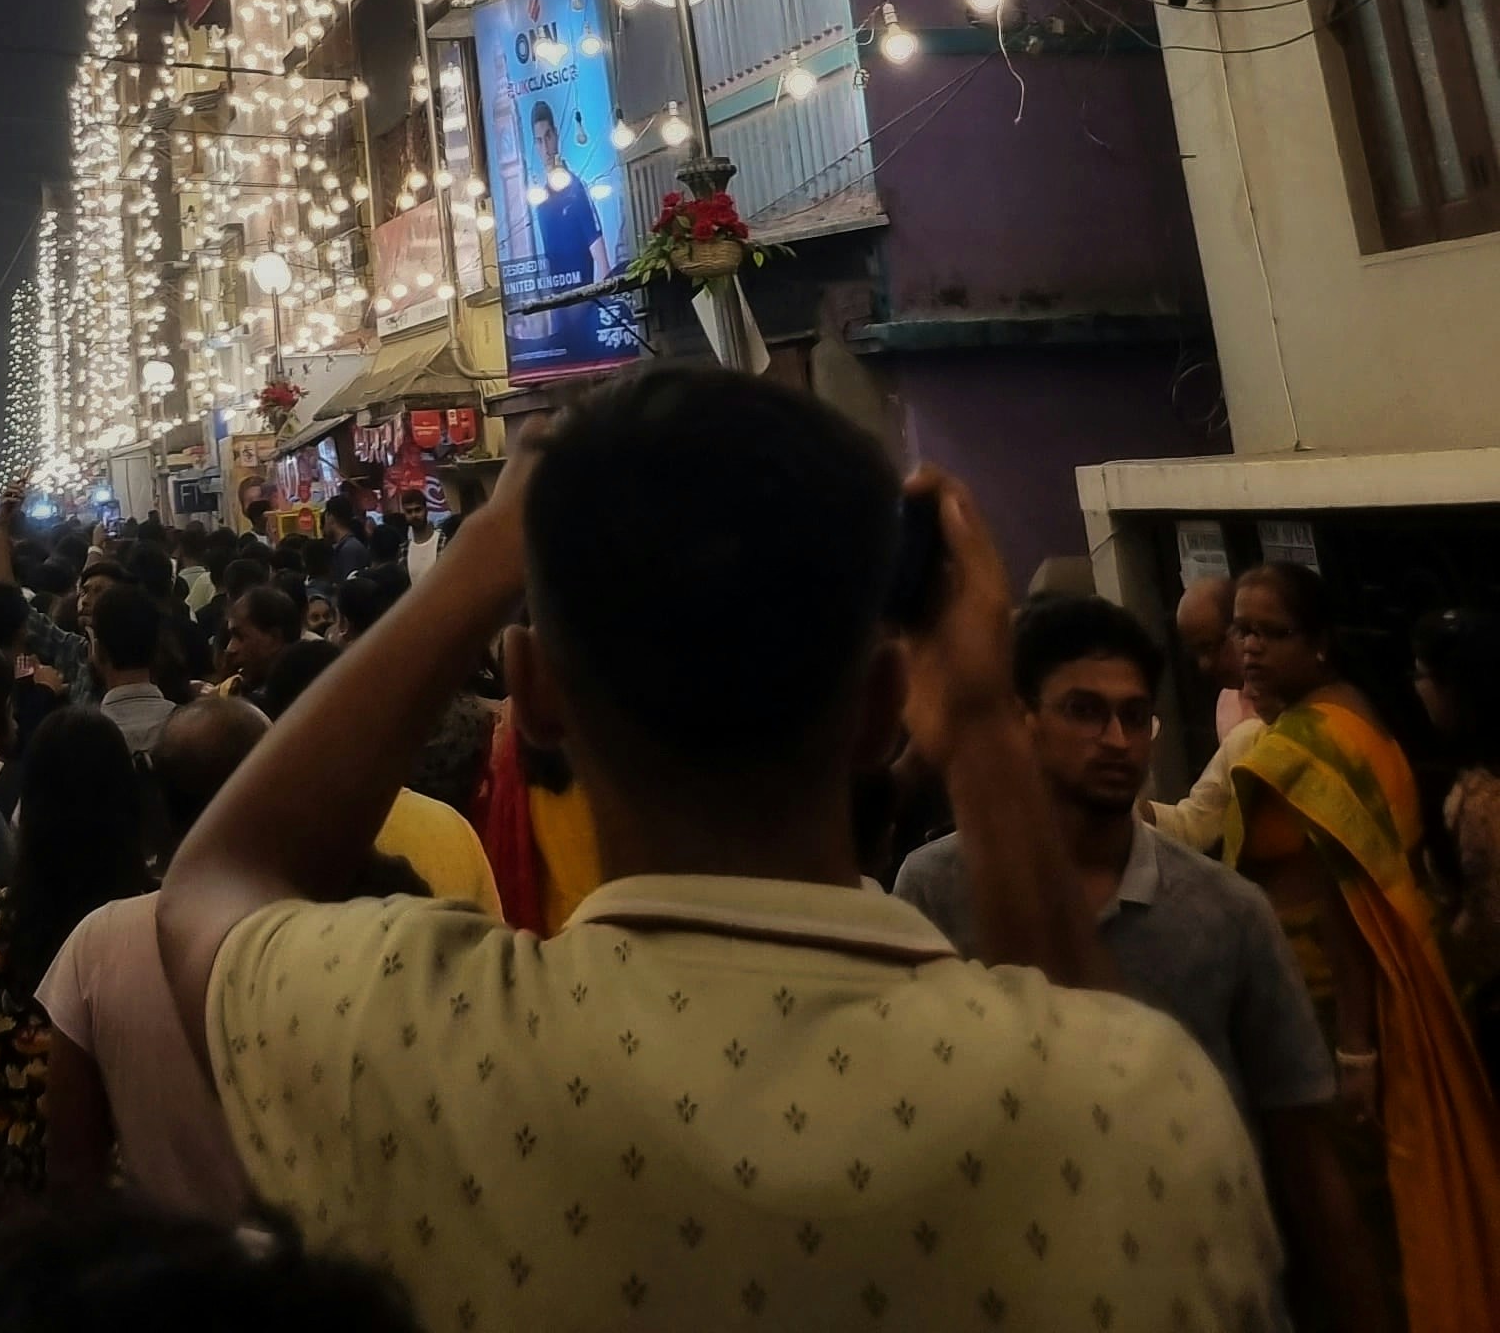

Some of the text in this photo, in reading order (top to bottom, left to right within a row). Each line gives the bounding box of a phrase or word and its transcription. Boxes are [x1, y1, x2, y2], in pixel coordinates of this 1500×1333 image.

[502, 260, 537, 277] DESIGNED
[504, 271, 581, 295] UNITED KINGDOM
